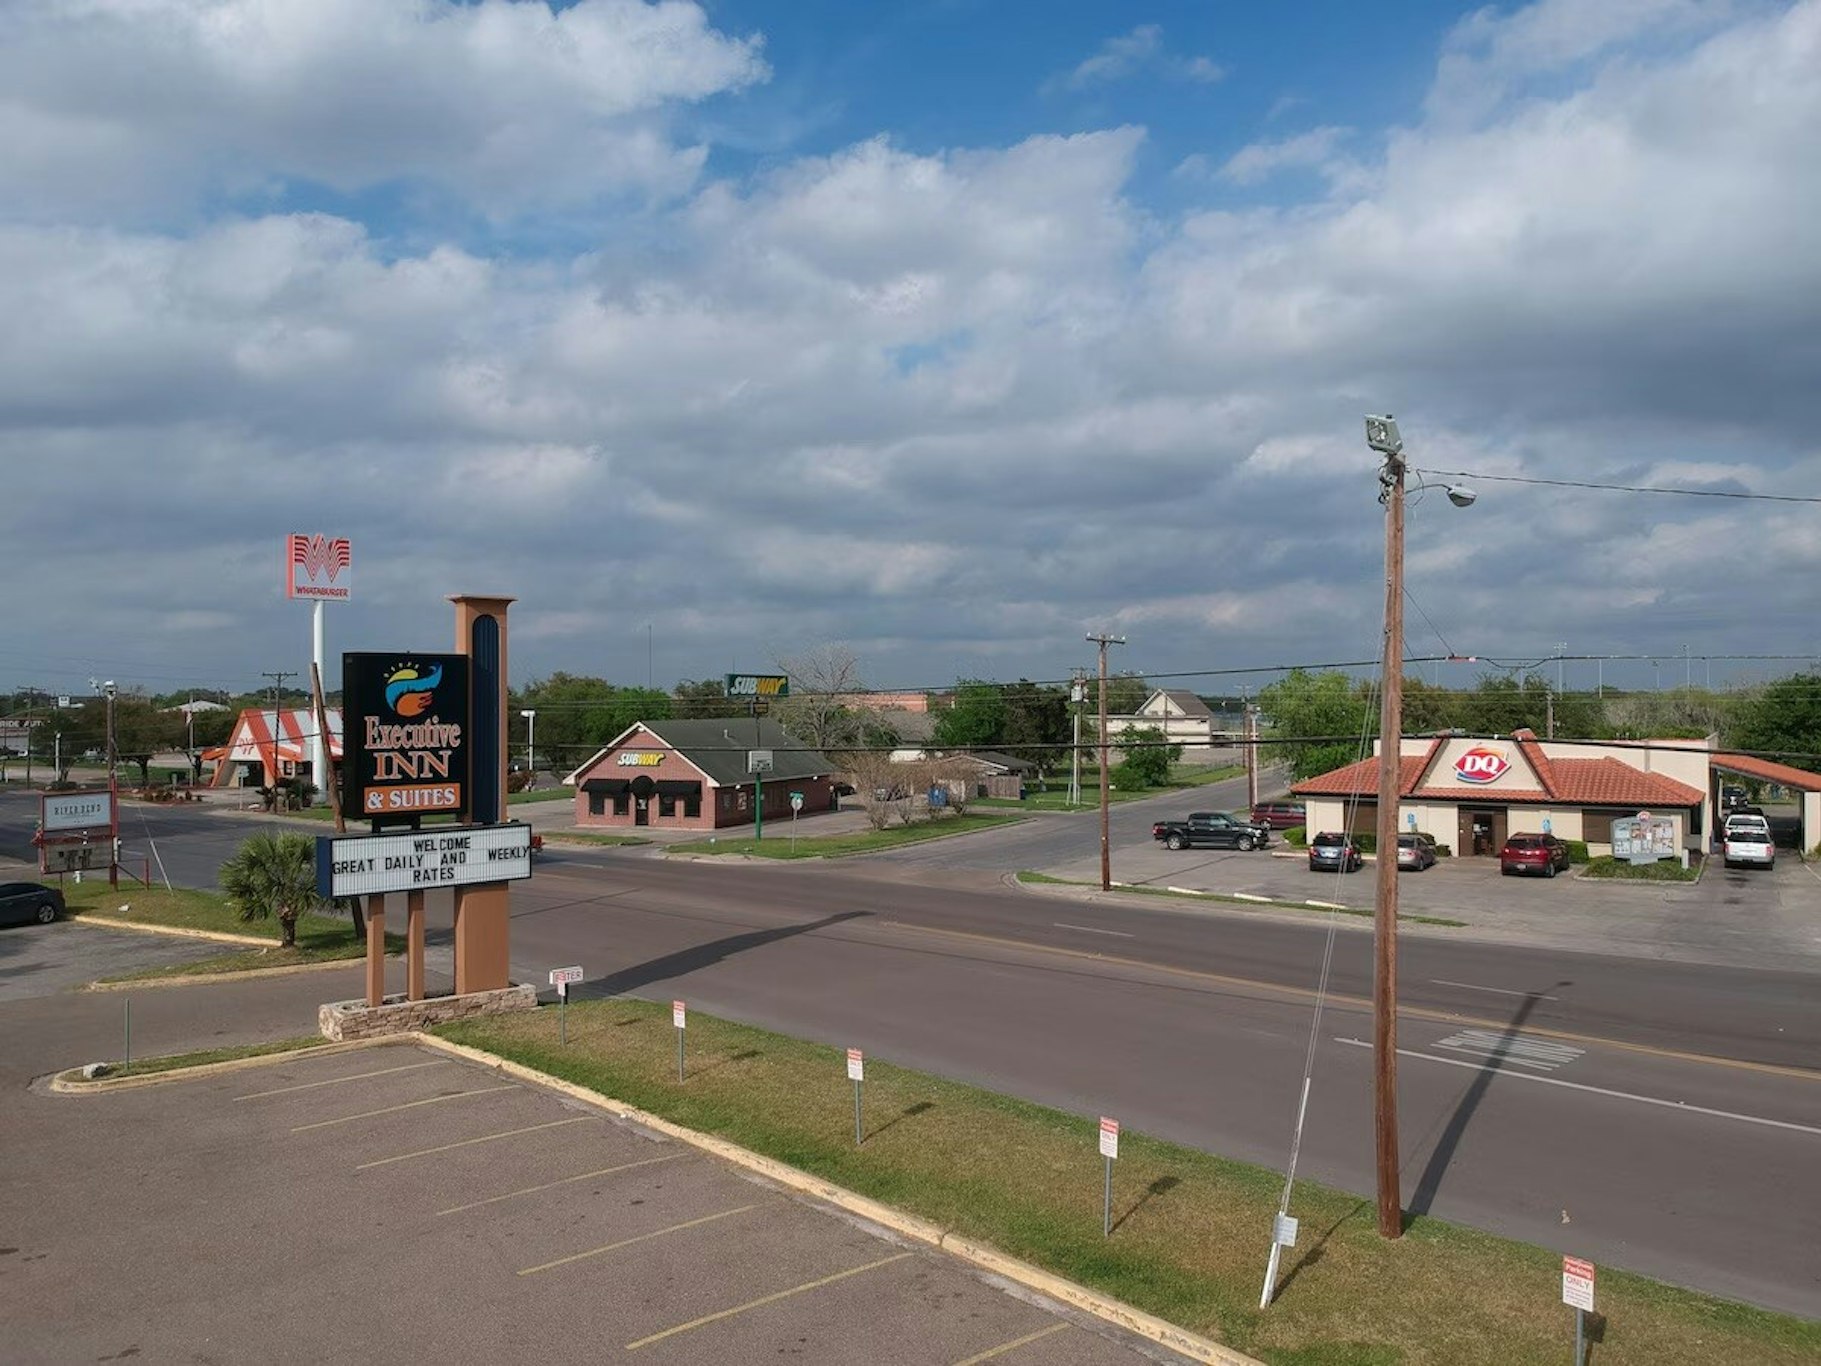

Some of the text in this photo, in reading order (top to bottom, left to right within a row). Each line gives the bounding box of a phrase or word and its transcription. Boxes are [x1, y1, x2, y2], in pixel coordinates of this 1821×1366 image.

[296, 585, 348, 597] WHATABURGER
[730, 676, 787, 695] SUBWAY
[364, 715, 461, 749] Executive
[373, 750, 452, 780] INN
[617, 752, 666, 767] SUBWAY
[1463, 754, 1500, 775] DQ
[367, 788, 455, 809] & SUITES
[413, 836, 471, 853] WELCOME
[332, 845, 530, 875] GREAT DAILY AND WEEKLY
[413, 867, 455, 883] RATES
[1566, 1275, 1590, 1290] ONLY
